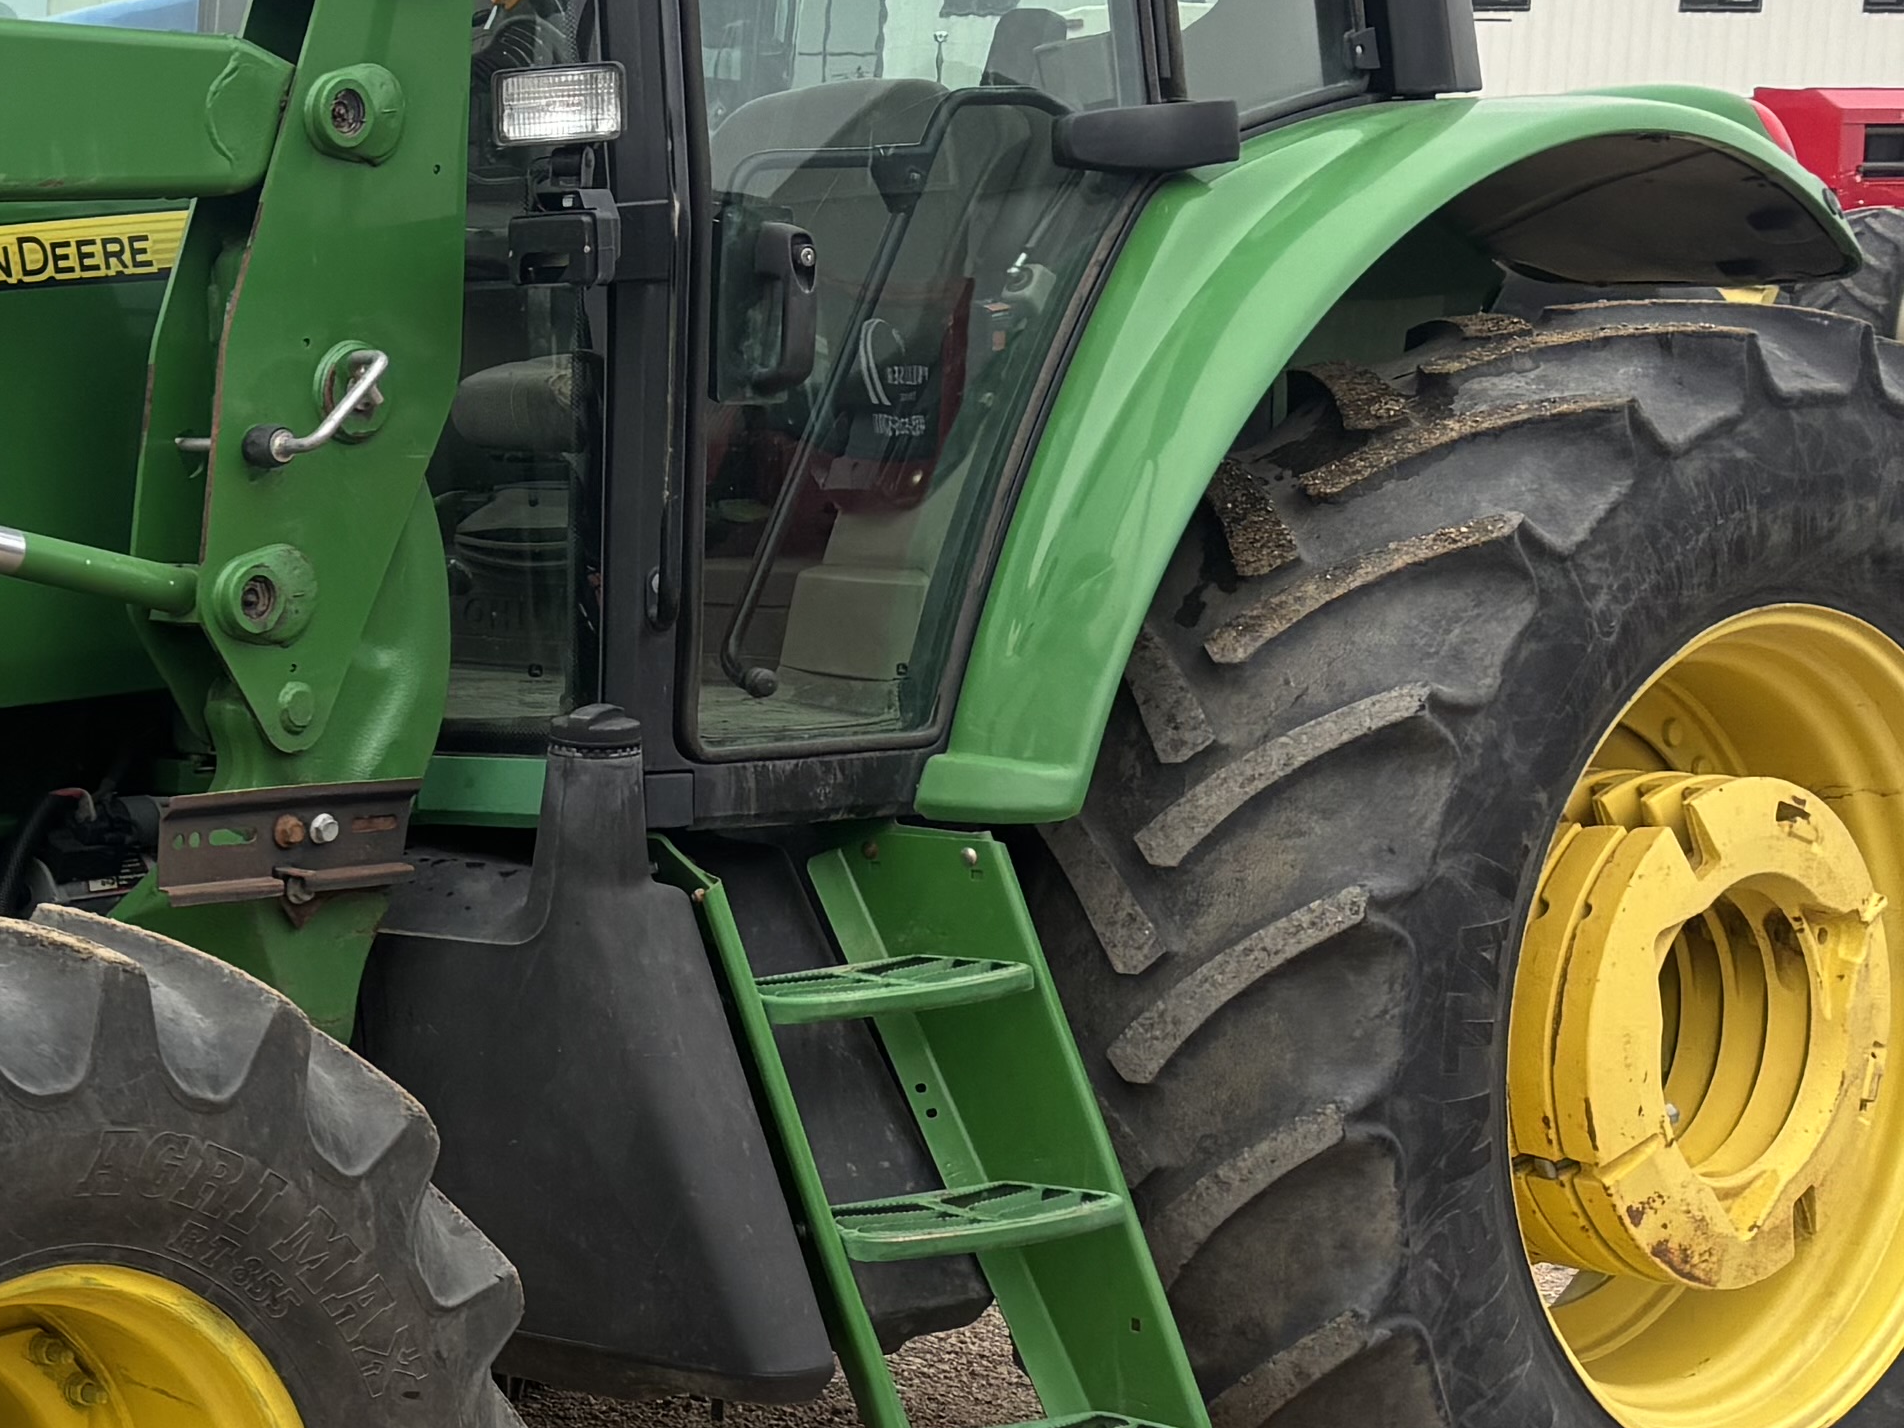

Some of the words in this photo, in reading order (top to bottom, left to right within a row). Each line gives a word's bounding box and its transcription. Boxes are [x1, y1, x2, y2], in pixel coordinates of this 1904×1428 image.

[15, 235, 154, 278] DEERE
[73, 1129, 289, 1235] AGRI
[268, 1204, 429, 1398] MAX
[164, 1219, 242, 1270] RT
[231, 1256, 304, 1319] 855
